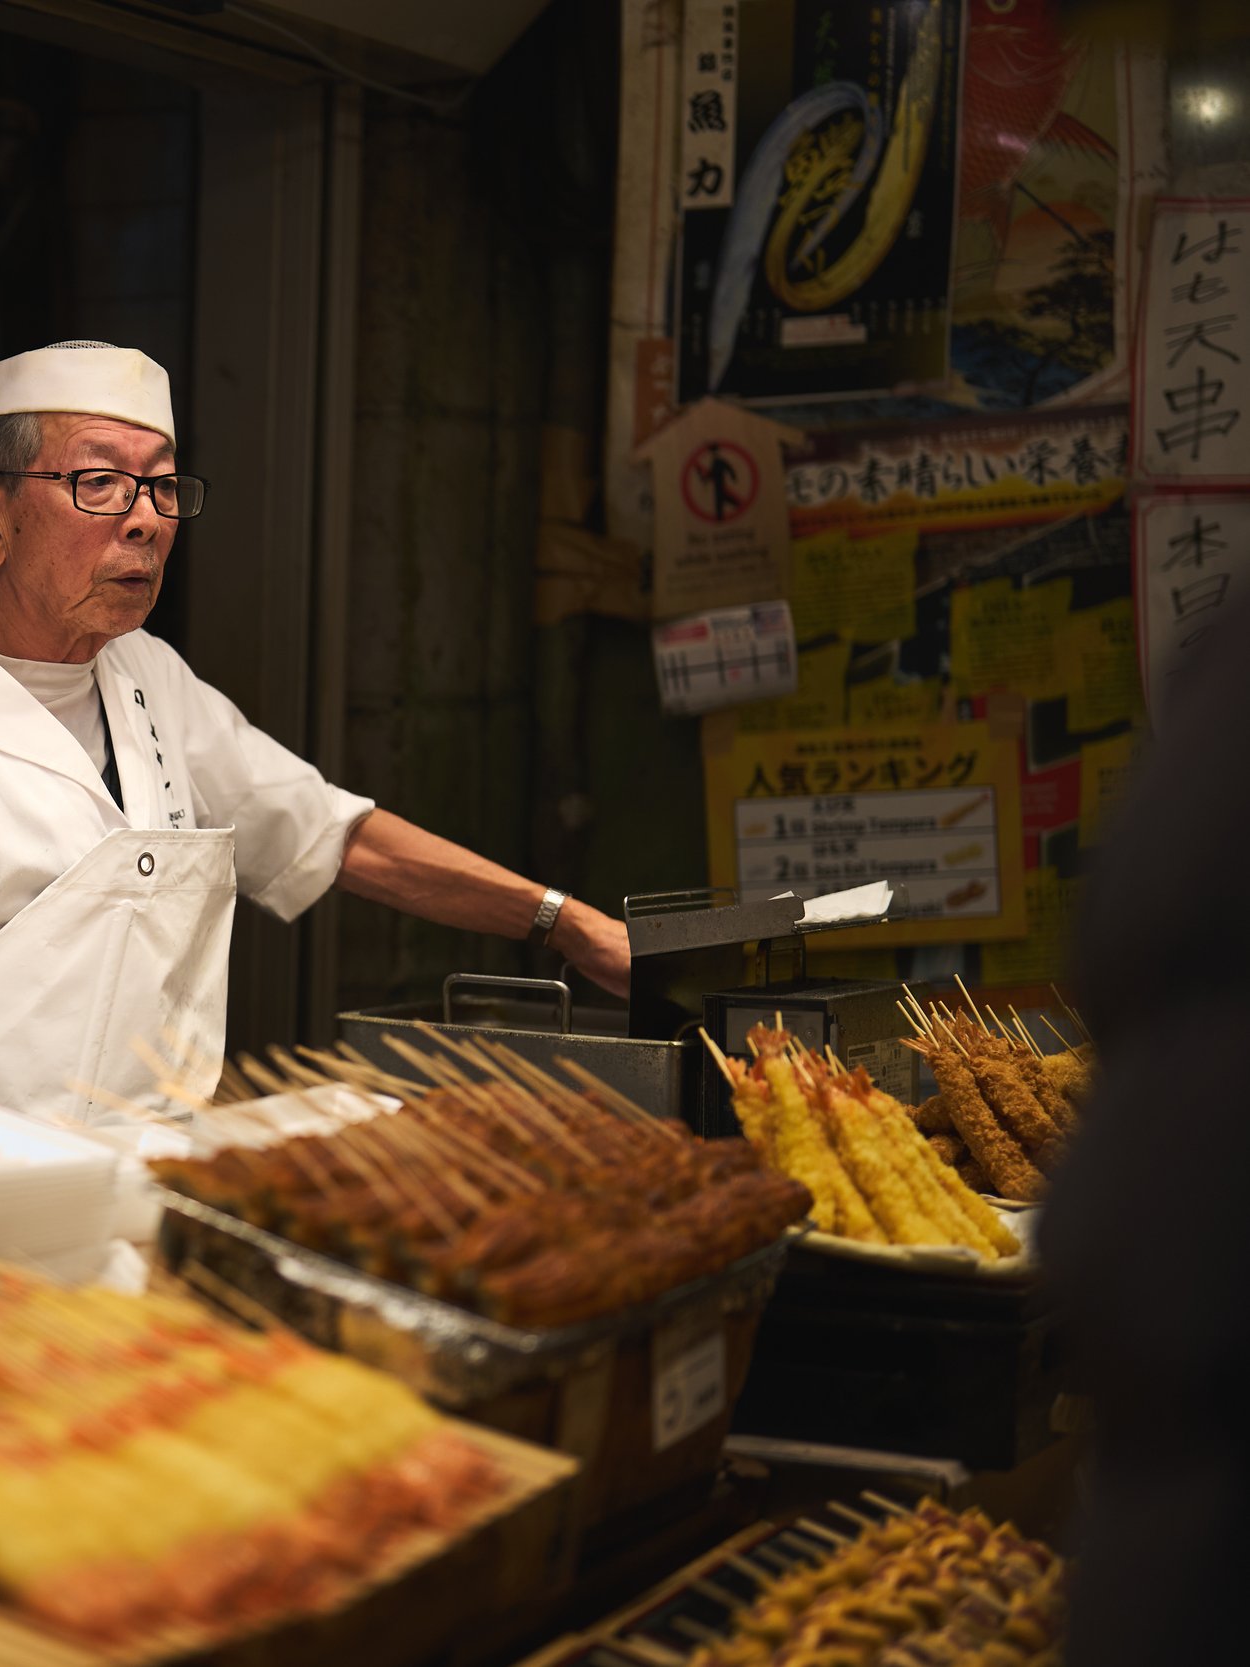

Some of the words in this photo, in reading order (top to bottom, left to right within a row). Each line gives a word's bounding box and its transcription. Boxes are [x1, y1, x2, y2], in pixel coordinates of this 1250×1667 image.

[1156, 220, 1243, 461] はも天串
[746, 749, 979, 797] 人気ランキング
